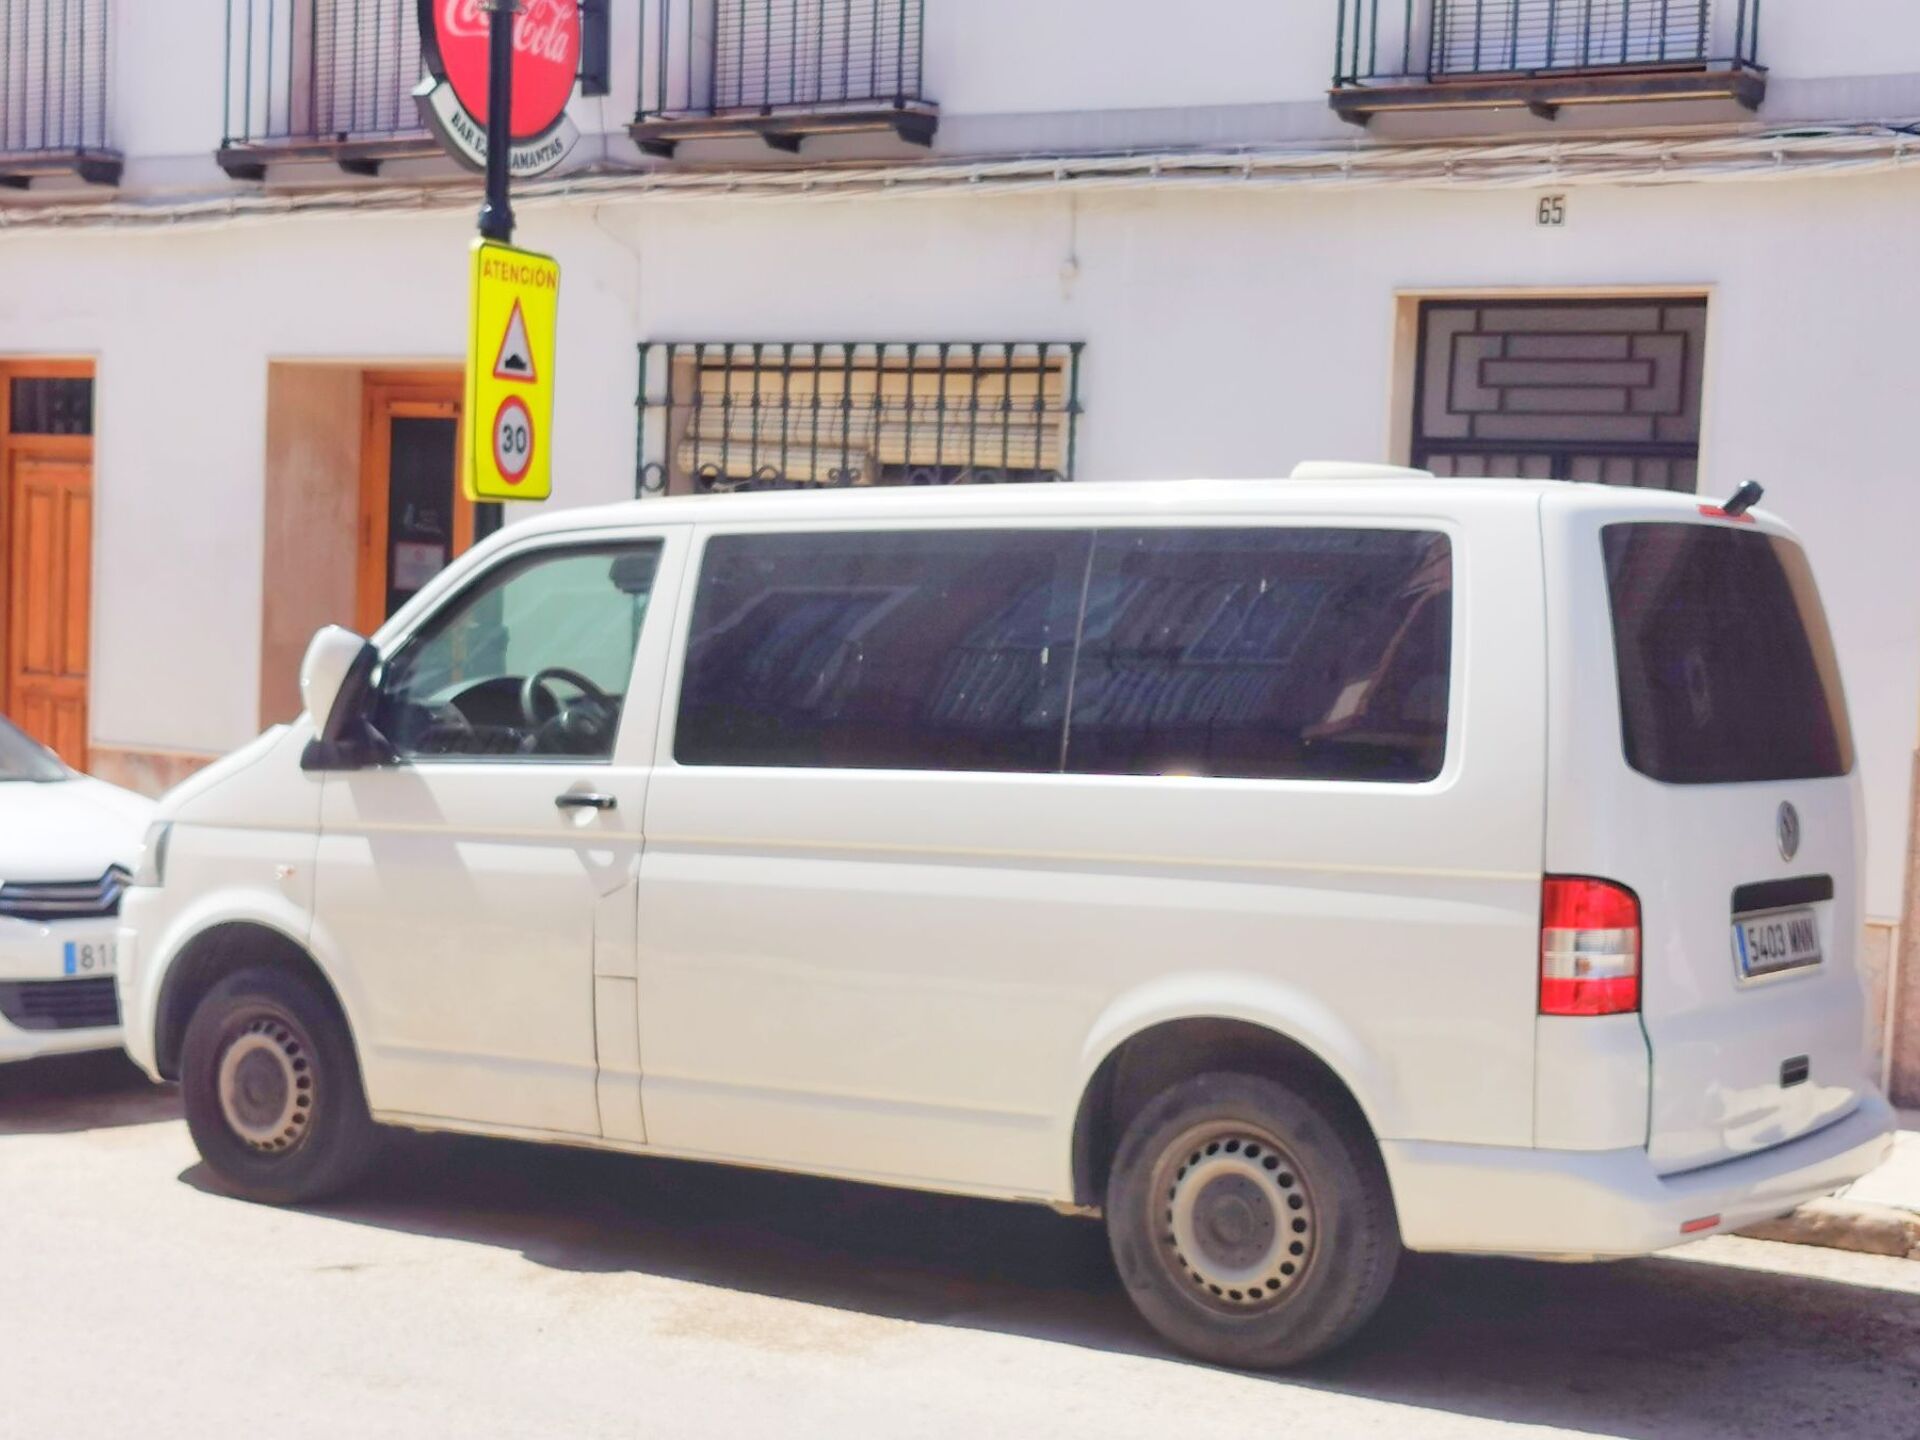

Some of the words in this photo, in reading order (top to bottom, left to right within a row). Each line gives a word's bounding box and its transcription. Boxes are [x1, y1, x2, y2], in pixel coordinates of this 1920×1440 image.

[451, 111, 475, 142] BAR
[1538, 195, 1564, 225] 65
[502, 424, 528, 454] 30
[1747, 924, 1786, 962] 5403
